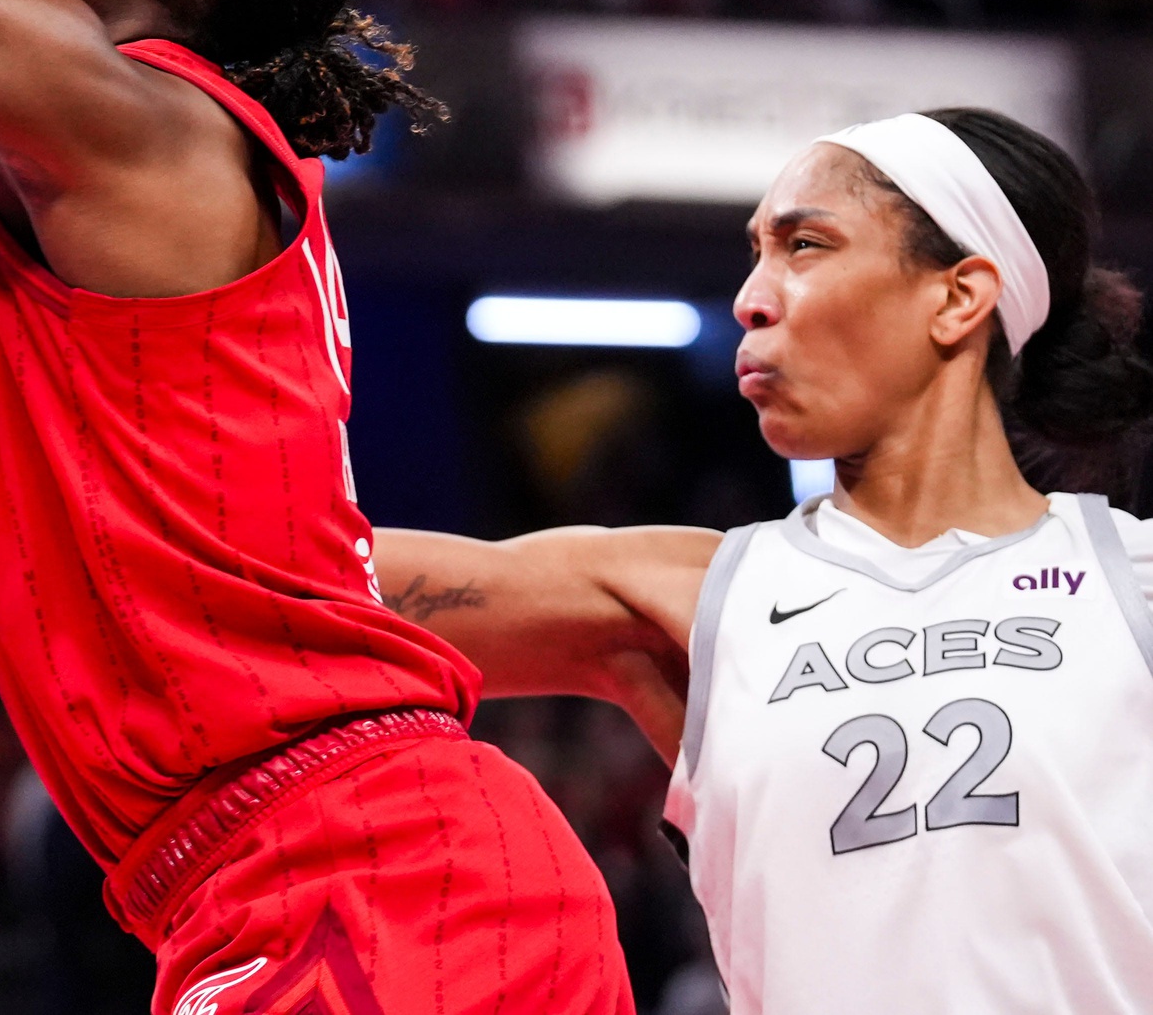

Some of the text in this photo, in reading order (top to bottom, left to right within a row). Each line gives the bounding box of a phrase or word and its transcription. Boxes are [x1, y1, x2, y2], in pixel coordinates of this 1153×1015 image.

[1012, 566, 1087, 596] ally
[767, 616, 1063, 704] ACES
[822, 697, 1020, 856] 22
